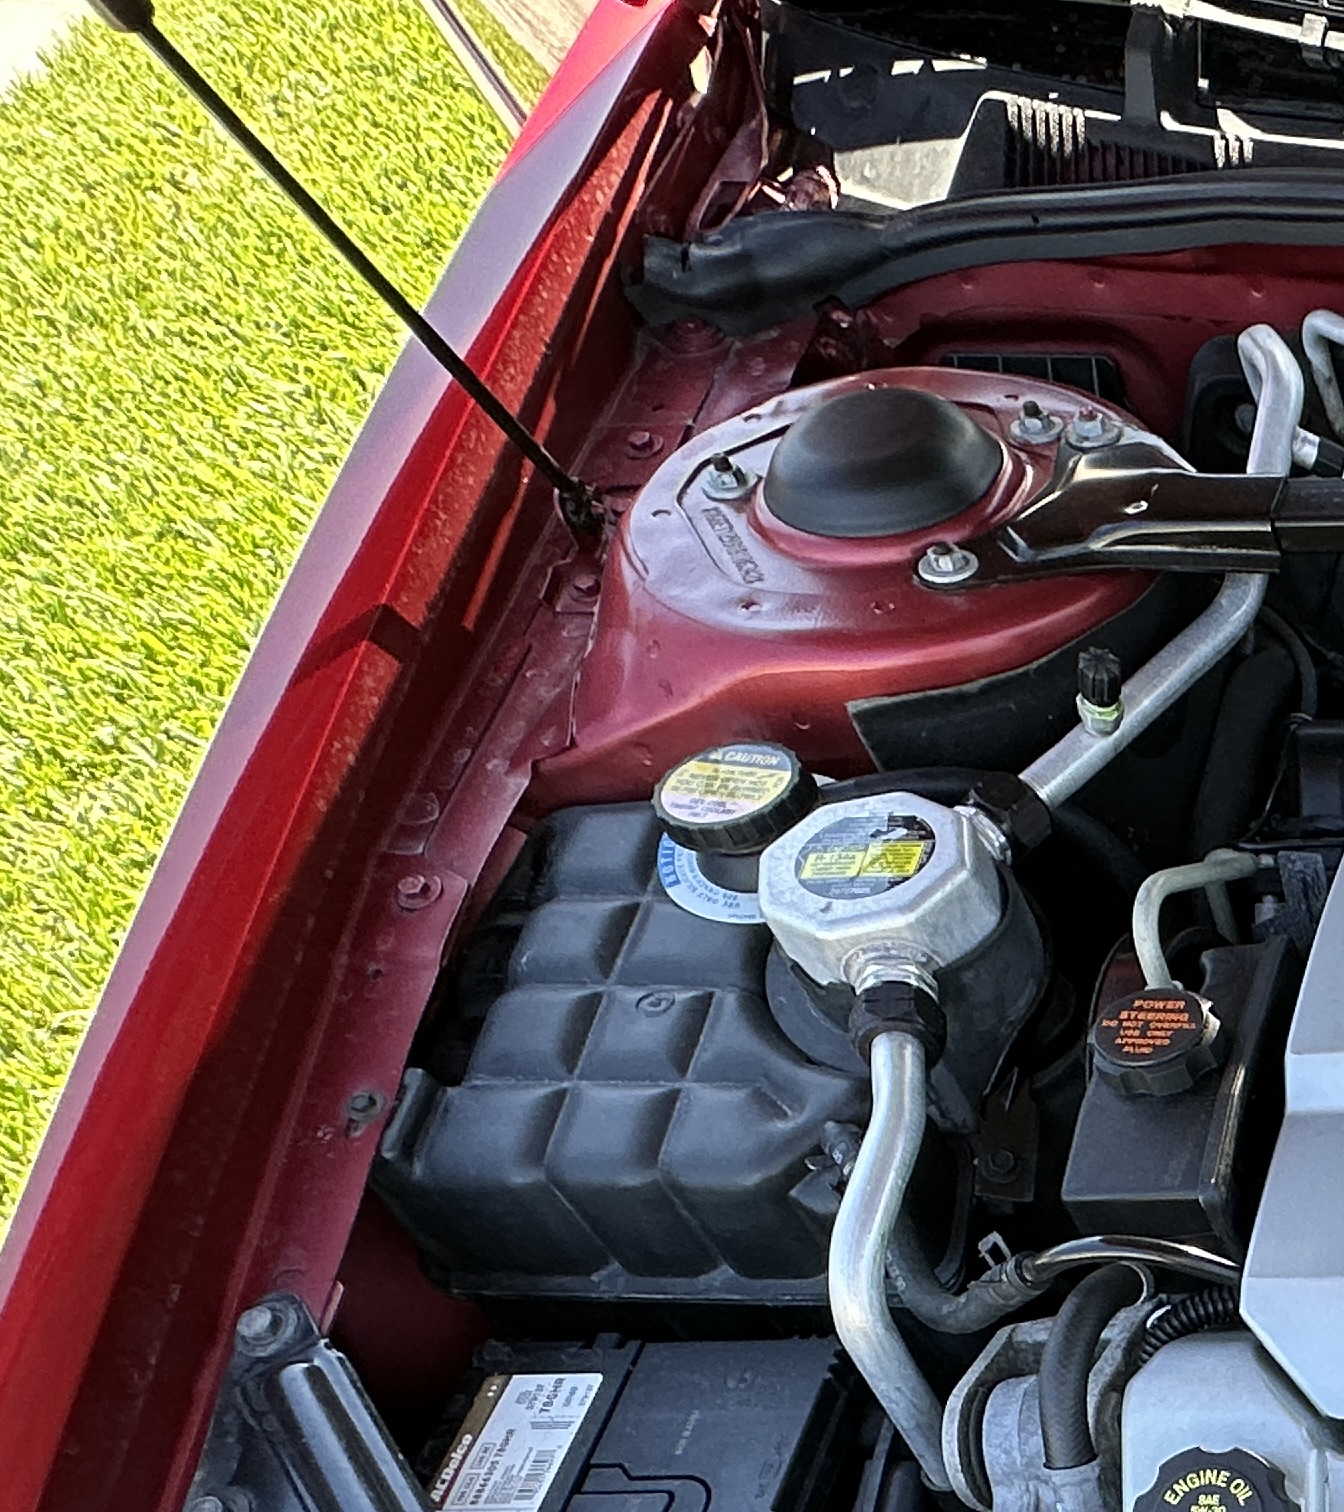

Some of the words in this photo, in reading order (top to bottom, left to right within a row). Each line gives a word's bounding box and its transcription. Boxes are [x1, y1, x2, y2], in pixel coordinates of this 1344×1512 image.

[724, 751, 781, 766] CAUTION
[1133, 999, 1186, 1010] POWER
[1119, 1010, 1190, 1022] STEERING
[1101, 1019, 1119, 1028] DO
[1122, 1020, 1144, 1028] NOT
[430, 1433, 473, 1503] ACDelco
[1163, 1469, 1231, 1505] ENGINE
[1229, 1479, 1253, 1507] OIL
[1198, 1494, 1220, 1506] SAE
